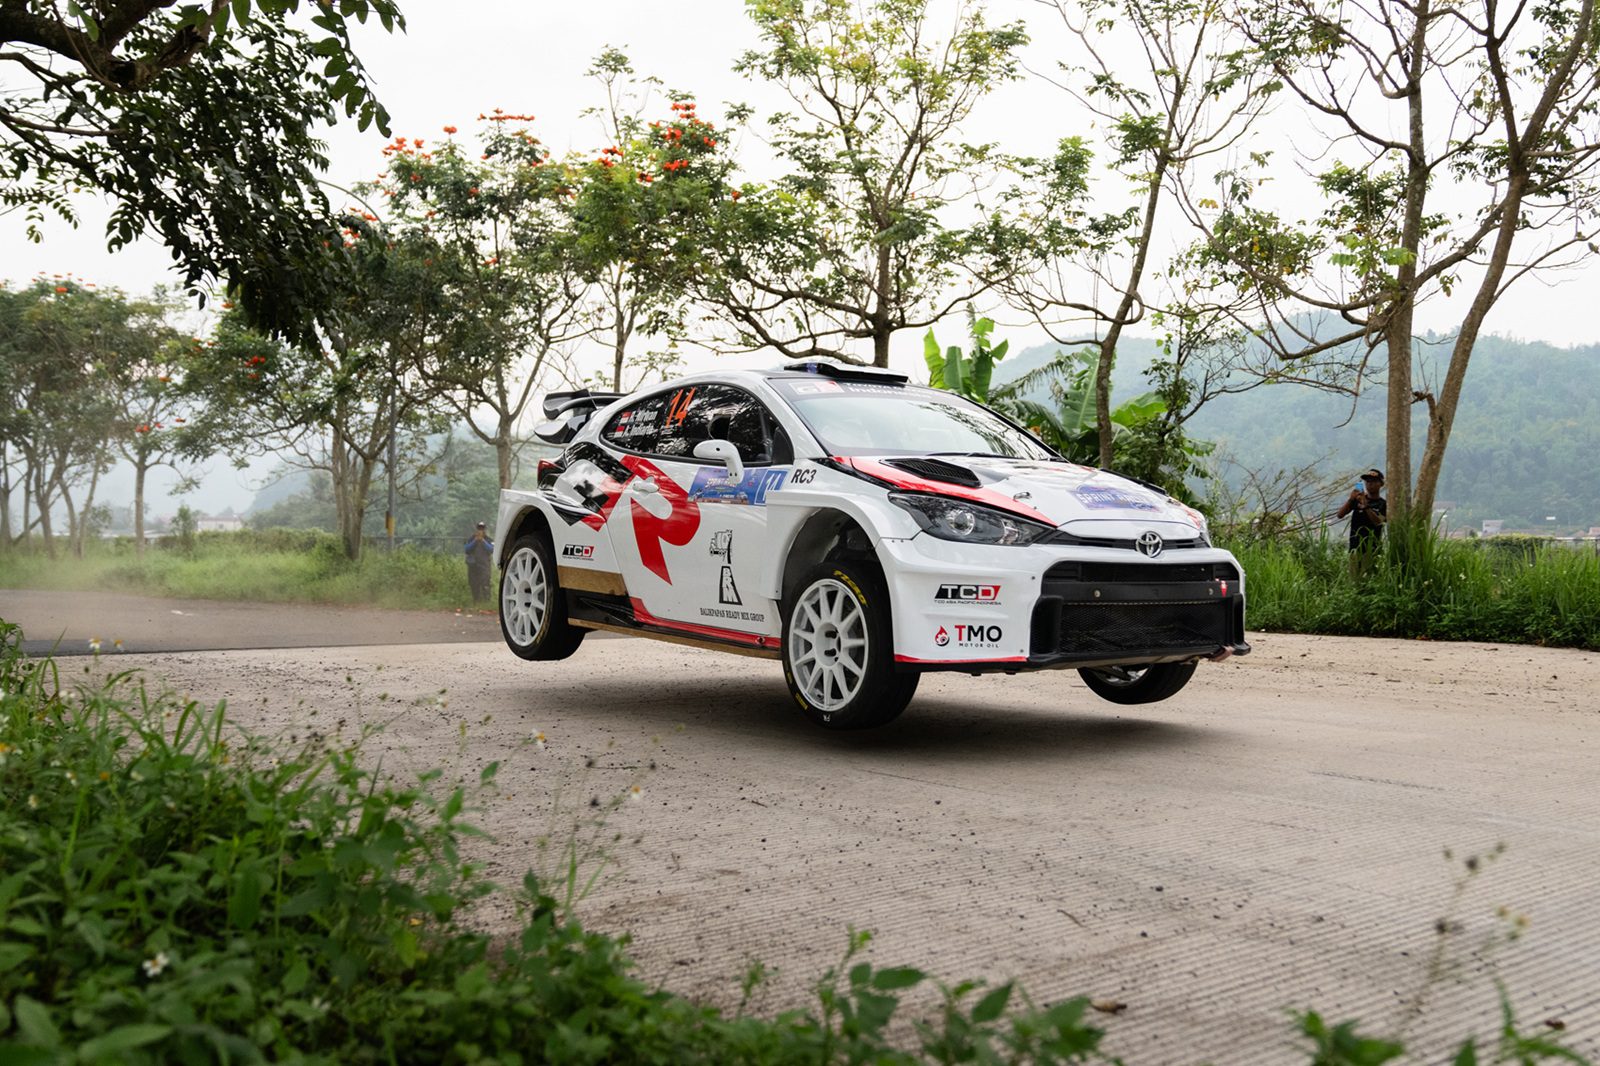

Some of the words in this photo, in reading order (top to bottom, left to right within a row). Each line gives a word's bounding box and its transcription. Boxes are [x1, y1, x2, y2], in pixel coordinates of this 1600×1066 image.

[665, 387, 696, 428] 14
[791, 469, 817, 484] RC3
[1077, 492, 1116, 505] SPRINT
[940, 584, 996, 600] TCD
[954, 625, 1003, 642] TMO
